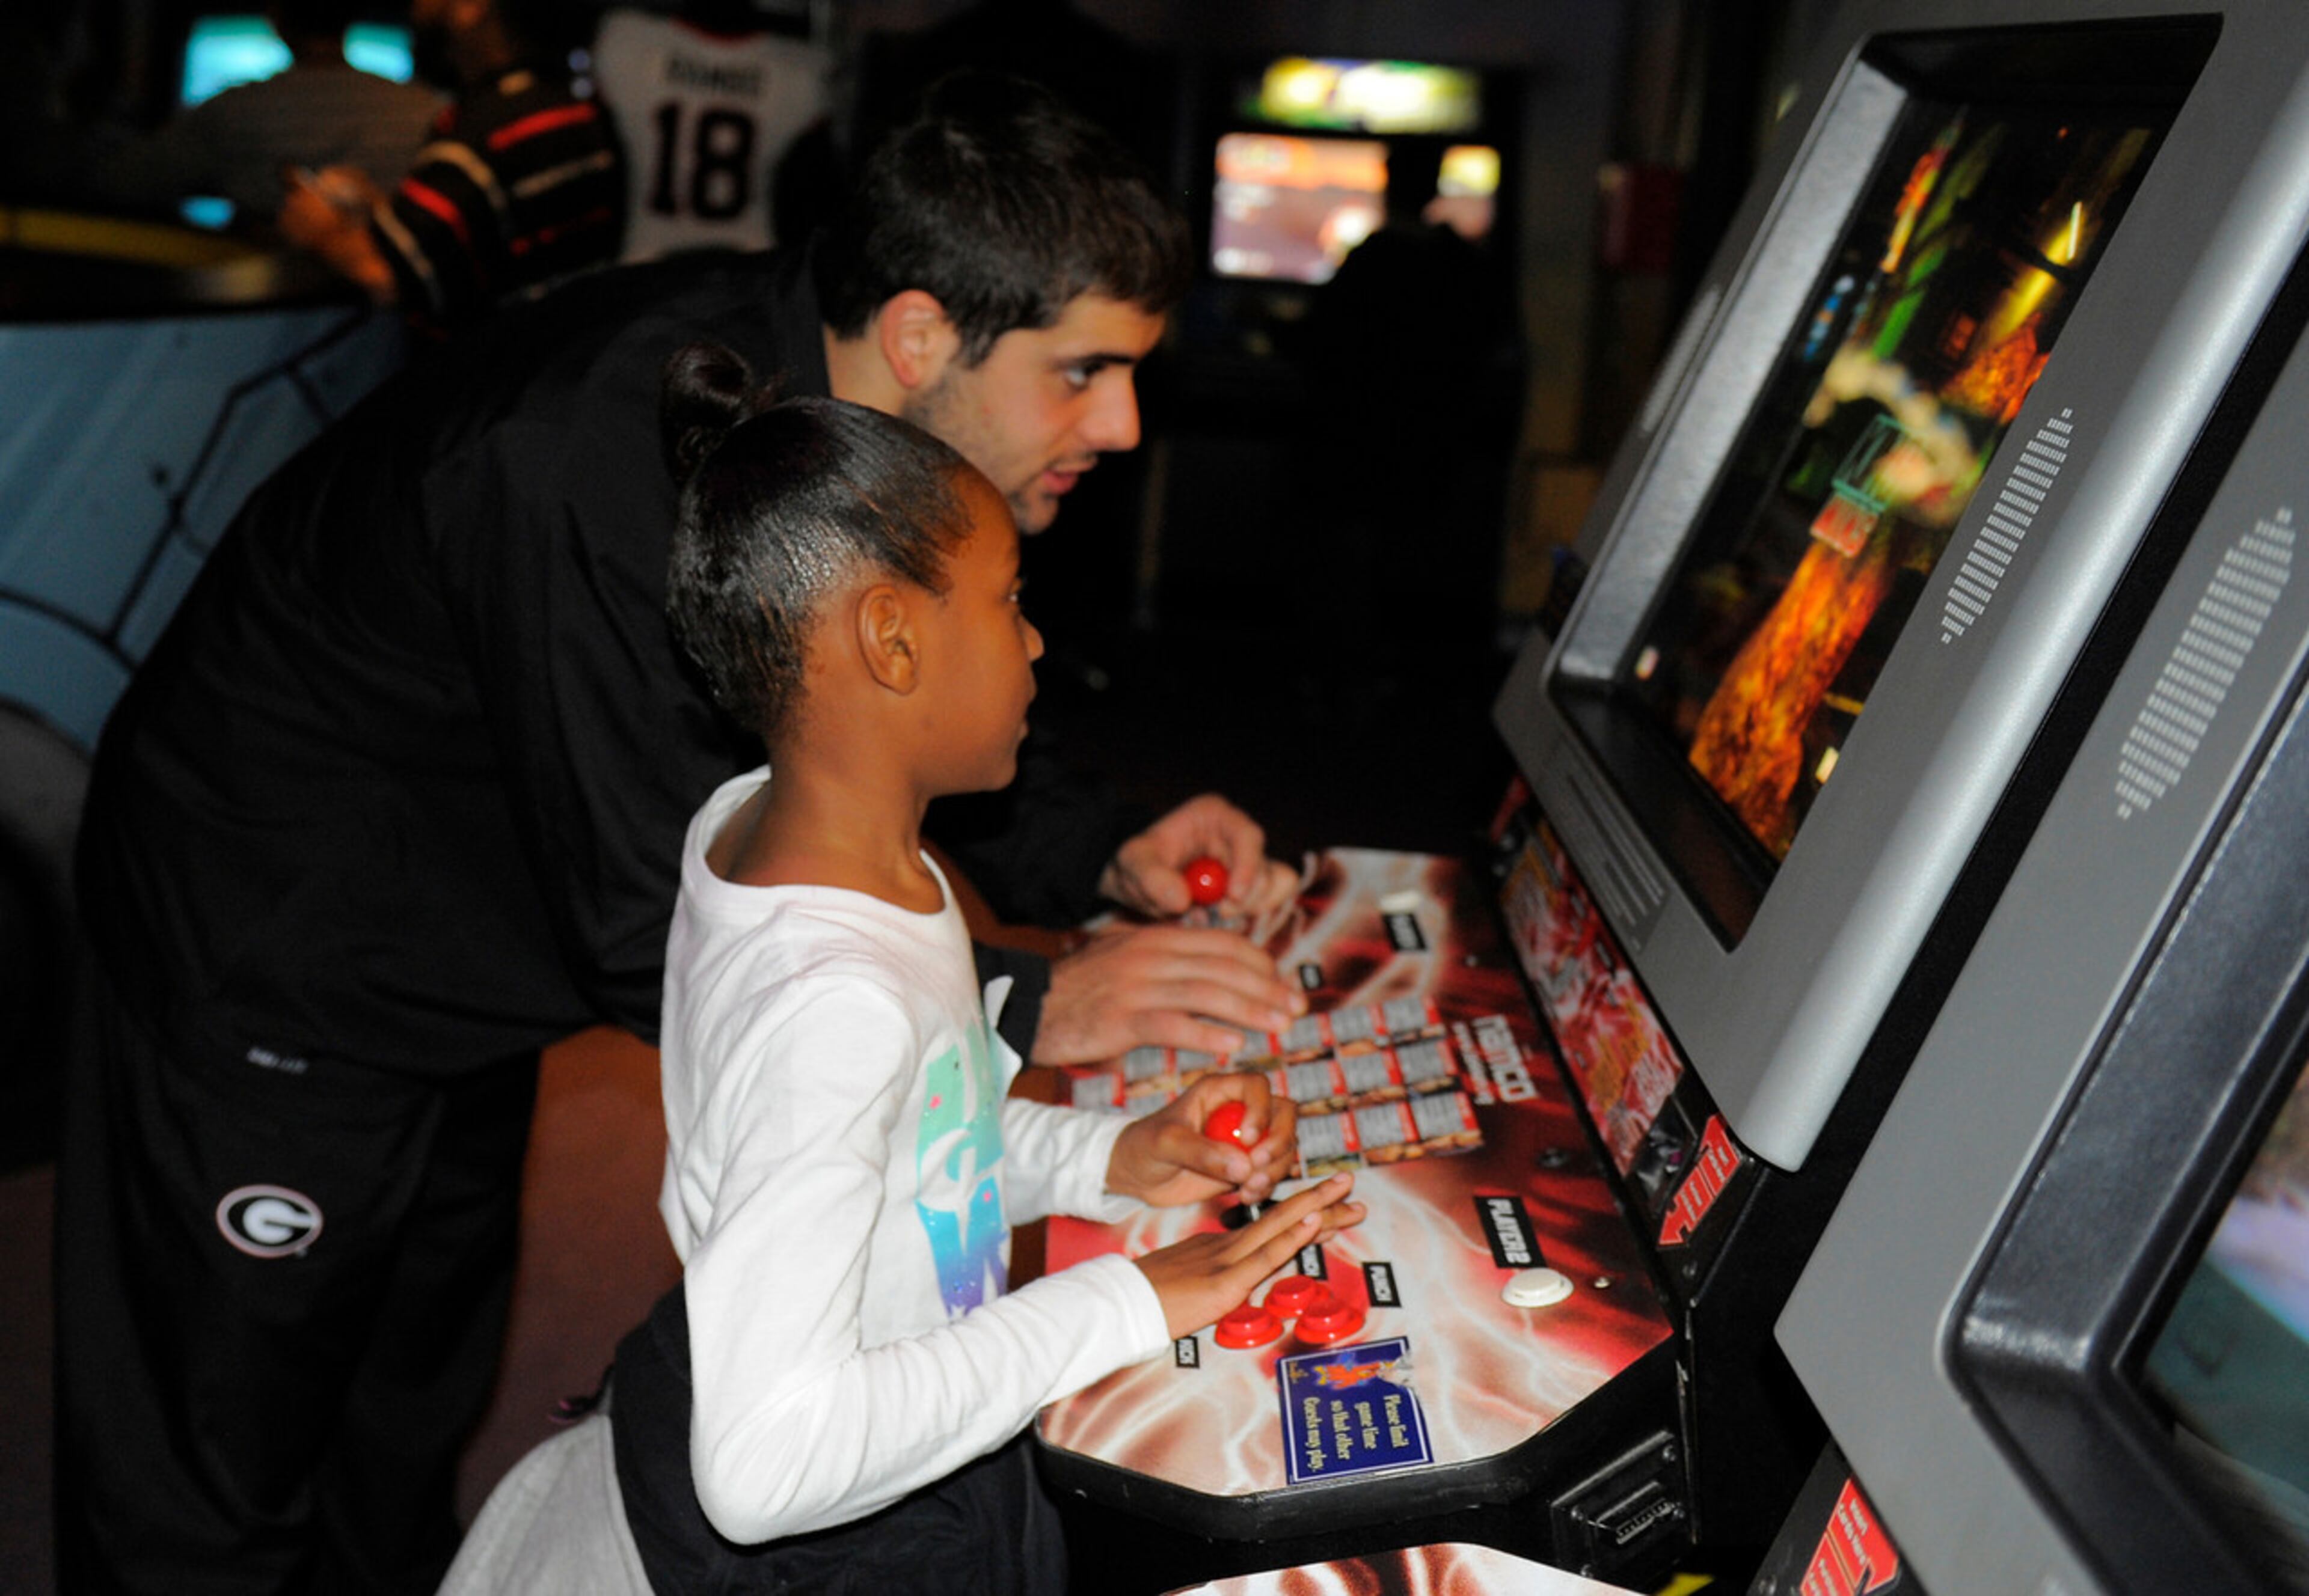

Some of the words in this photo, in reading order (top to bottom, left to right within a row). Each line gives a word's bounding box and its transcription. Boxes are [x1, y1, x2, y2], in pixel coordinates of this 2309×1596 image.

[648, 100, 756, 221] 18
[1303, 1396, 1322, 1429] Guests
[1330, 1399, 1343, 1412] so
[1354, 1401, 1373, 1426] game
[1384, 1394, 1402, 1425] Please
[1332, 1411, 1351, 1432] that
[1305, 1429, 1321, 1448] may
[1335, 1432, 1354, 1460] other
[1362, 1426, 1379, 1449] time
[1390, 1425, 1409, 1448] limit
